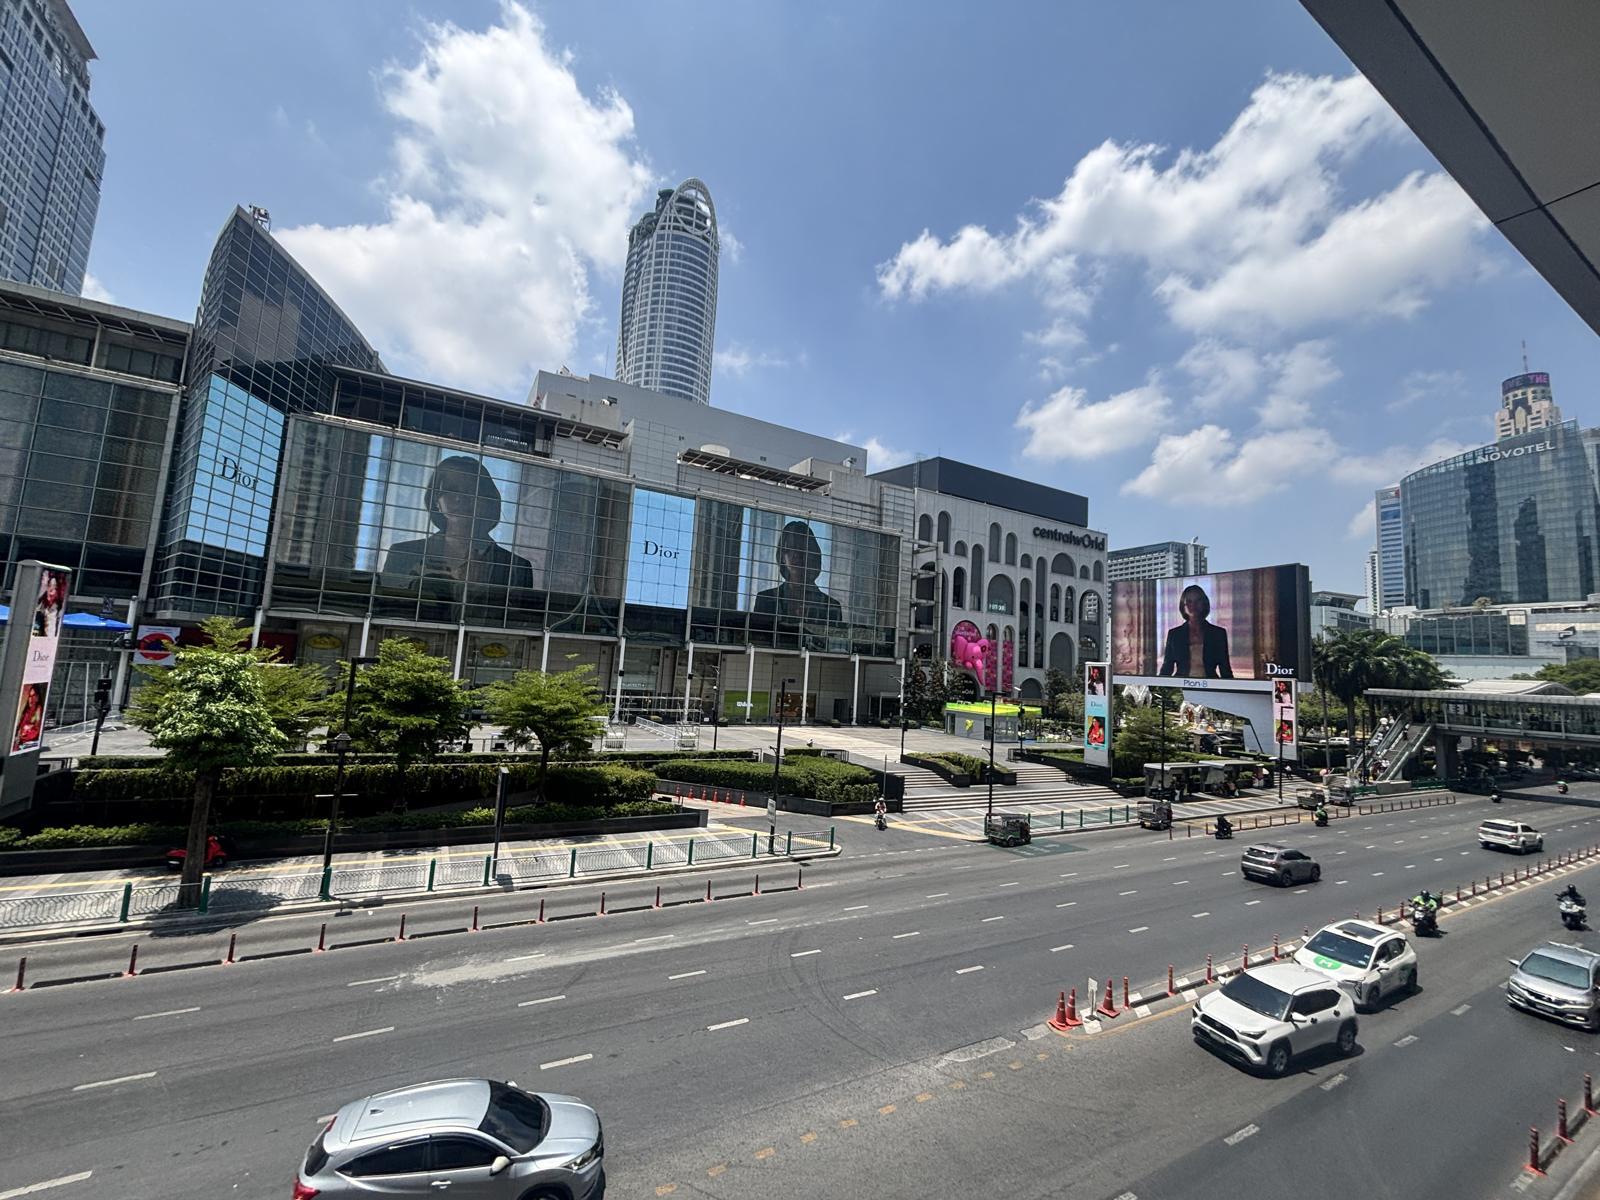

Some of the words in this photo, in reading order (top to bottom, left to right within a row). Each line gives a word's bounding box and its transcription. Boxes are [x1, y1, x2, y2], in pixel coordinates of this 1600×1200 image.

[1477, 440, 1556, 464] NOVOTEL
[221, 455, 259, 489] Dior
[644, 540, 680, 559] Dior
[1265, 662, 1295, 675] Dior
